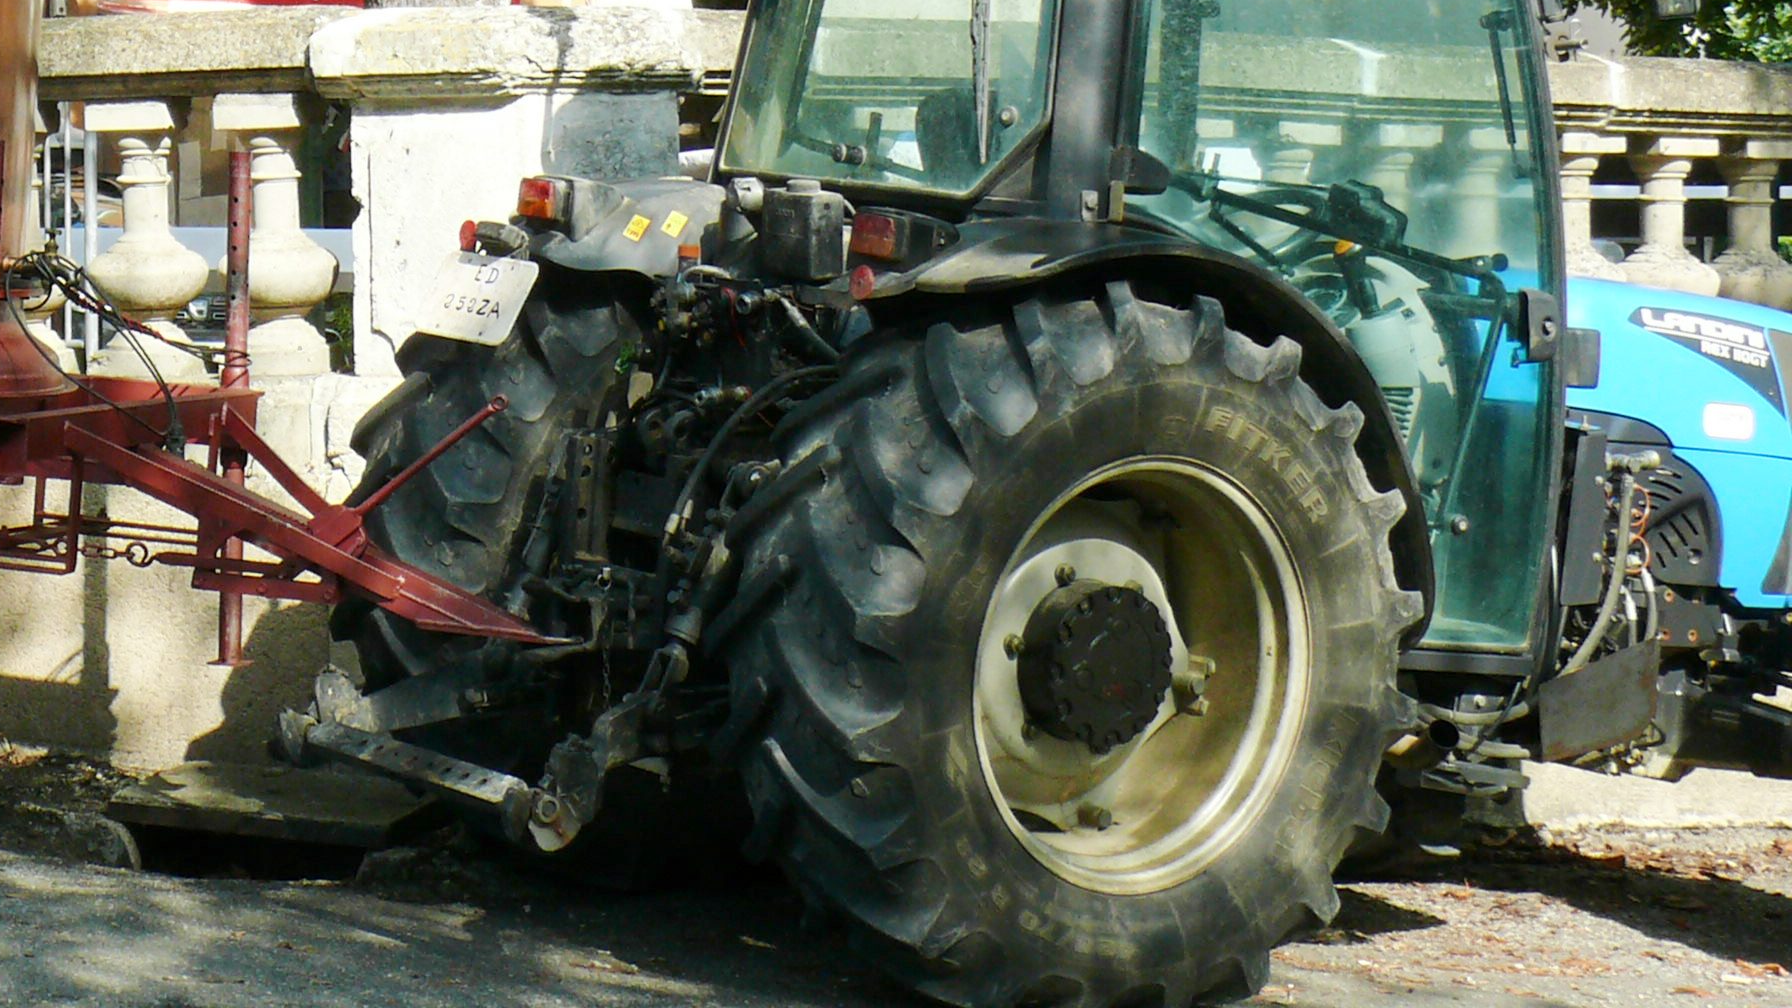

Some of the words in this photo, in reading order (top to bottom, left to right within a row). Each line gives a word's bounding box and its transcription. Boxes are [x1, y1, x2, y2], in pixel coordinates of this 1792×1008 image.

[474, 263, 500, 284] ED
[1639, 307, 1766, 350] LANDINI
[1701, 339, 1730, 359] REX
[1204, 405, 1329, 523] FITKER
